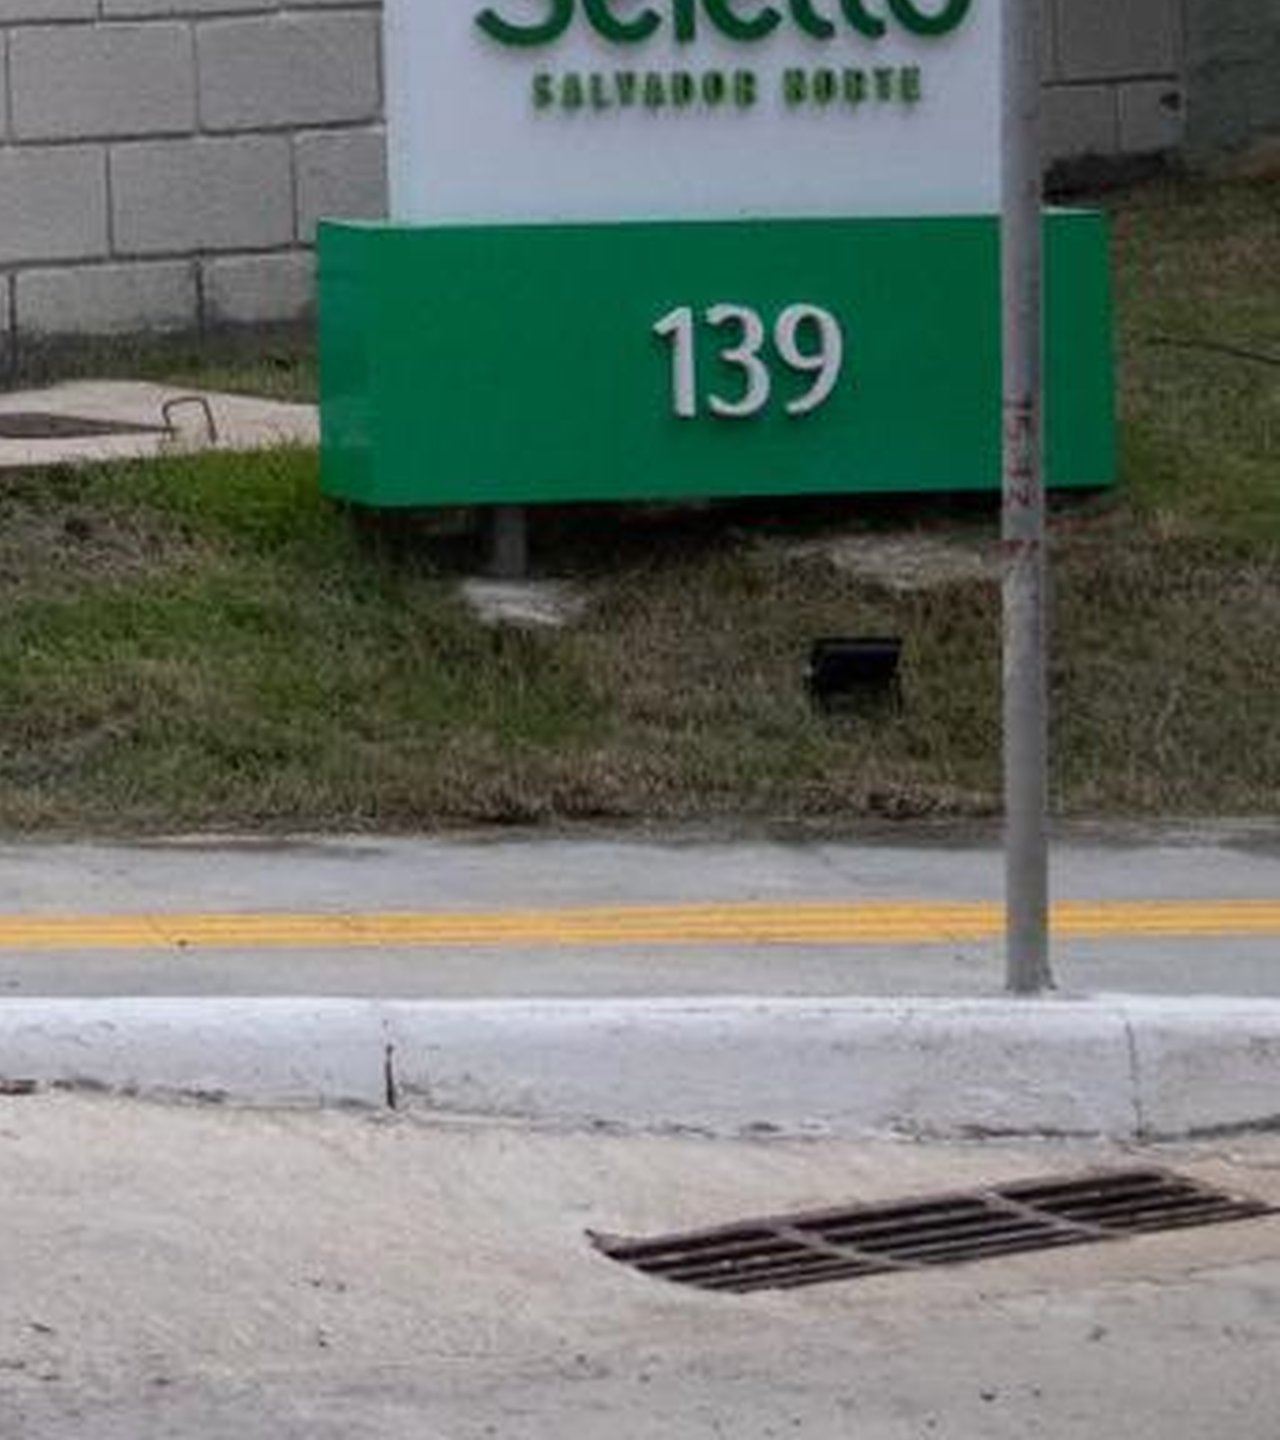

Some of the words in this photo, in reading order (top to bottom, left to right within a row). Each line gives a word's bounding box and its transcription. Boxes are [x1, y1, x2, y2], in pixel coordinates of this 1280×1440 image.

[532, 68, 757, 109] SALVADOR
[783, 64, 921, 105] NORTE
[653, 302, 843, 418] 139
